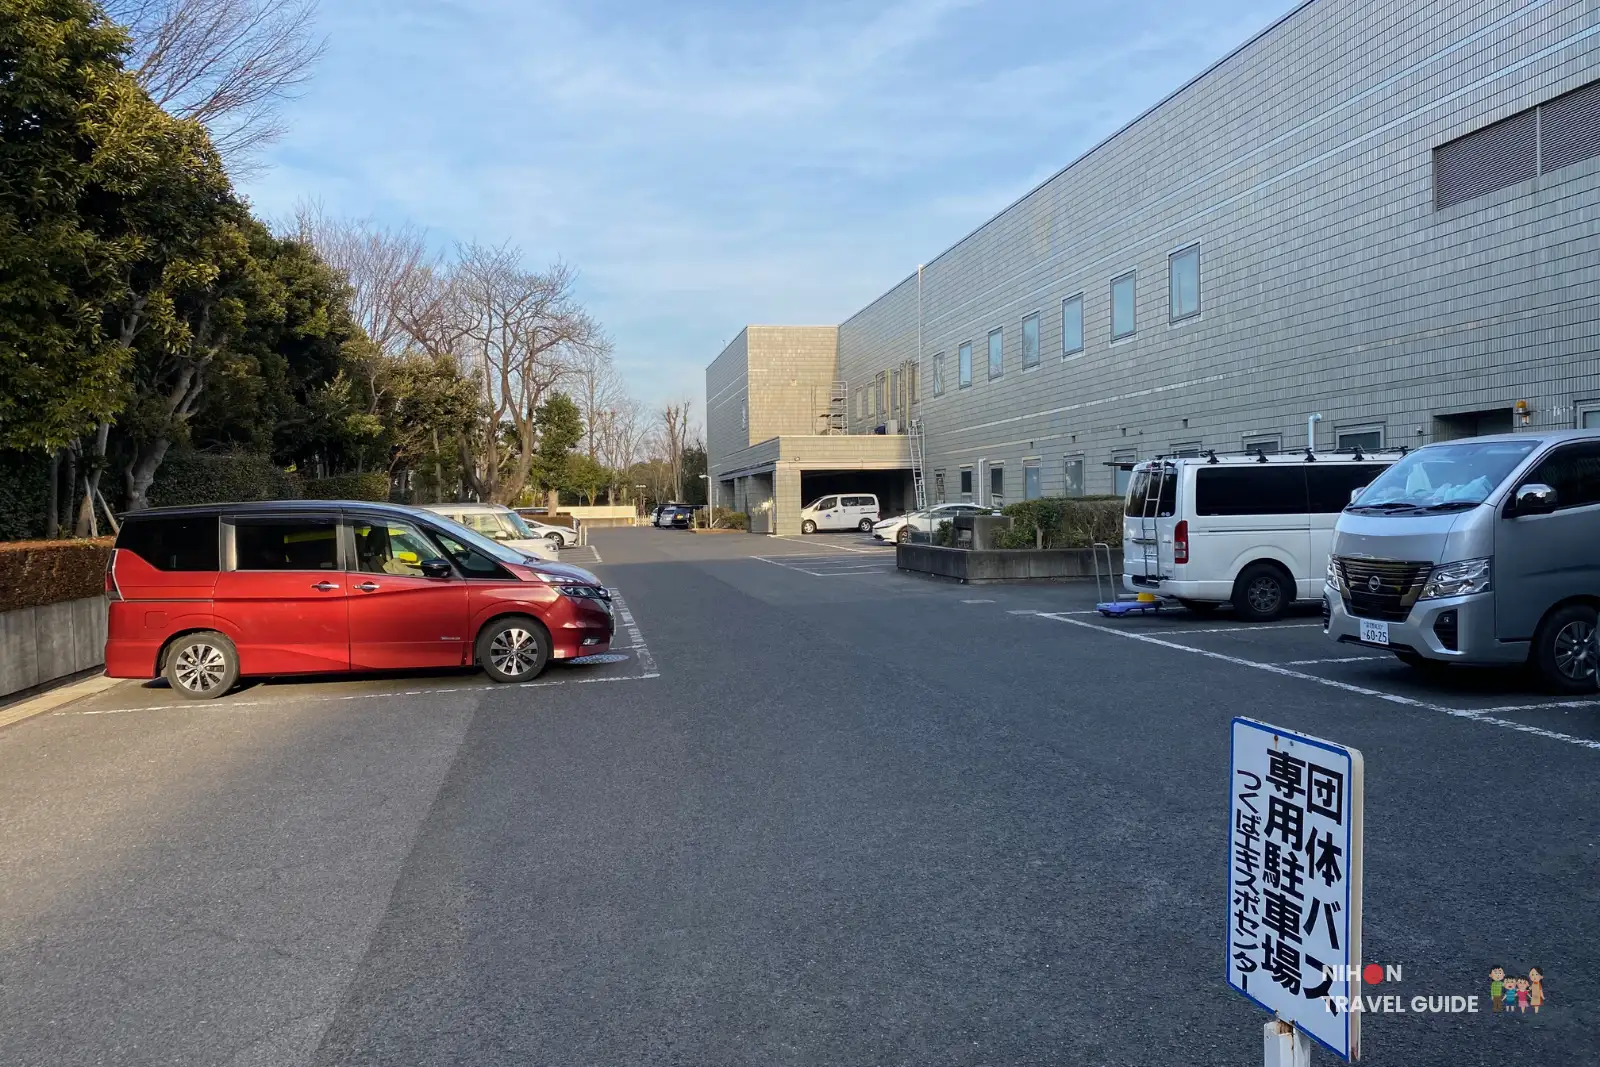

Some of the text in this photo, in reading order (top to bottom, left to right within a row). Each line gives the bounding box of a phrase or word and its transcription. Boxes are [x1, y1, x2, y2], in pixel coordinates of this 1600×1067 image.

[1233, 770, 1261, 992] つくばエキスポセンター
[1261, 748, 1306, 995] 専用駐車場
[1303, 762, 1343, 1017] 団体バス
